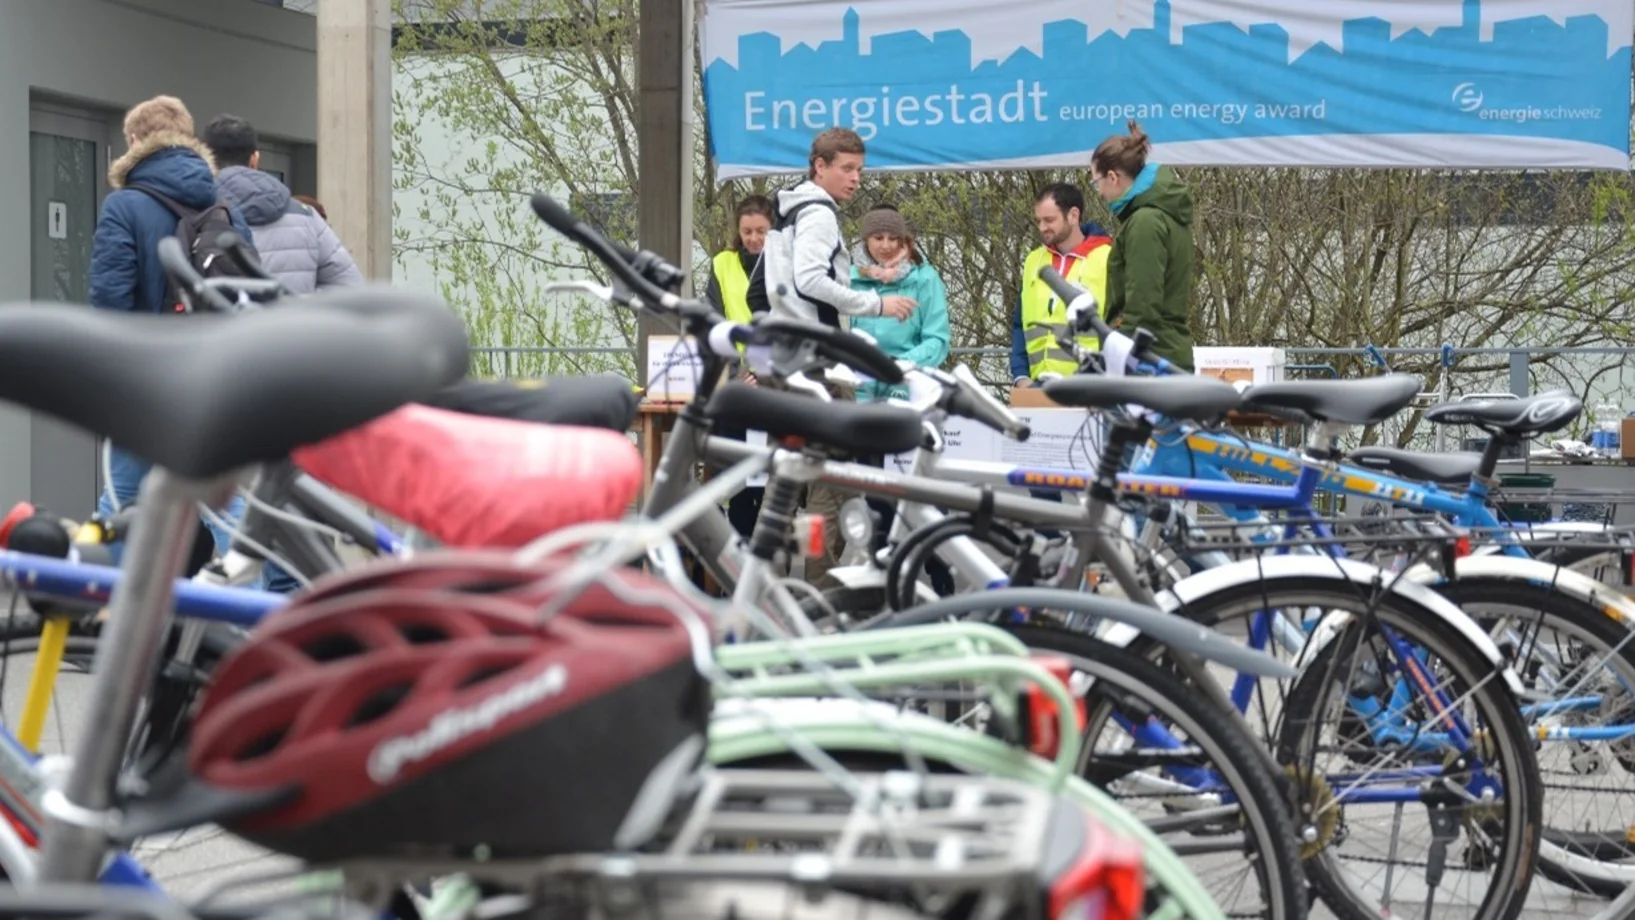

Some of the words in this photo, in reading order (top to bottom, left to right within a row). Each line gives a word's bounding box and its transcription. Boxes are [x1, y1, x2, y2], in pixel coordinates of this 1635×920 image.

[744, 79, 1048, 141] Energiestadt
[1059, 103, 1163, 124] european
[1170, 102, 1248, 123] energy
[1254, 99, 1326, 119] award
